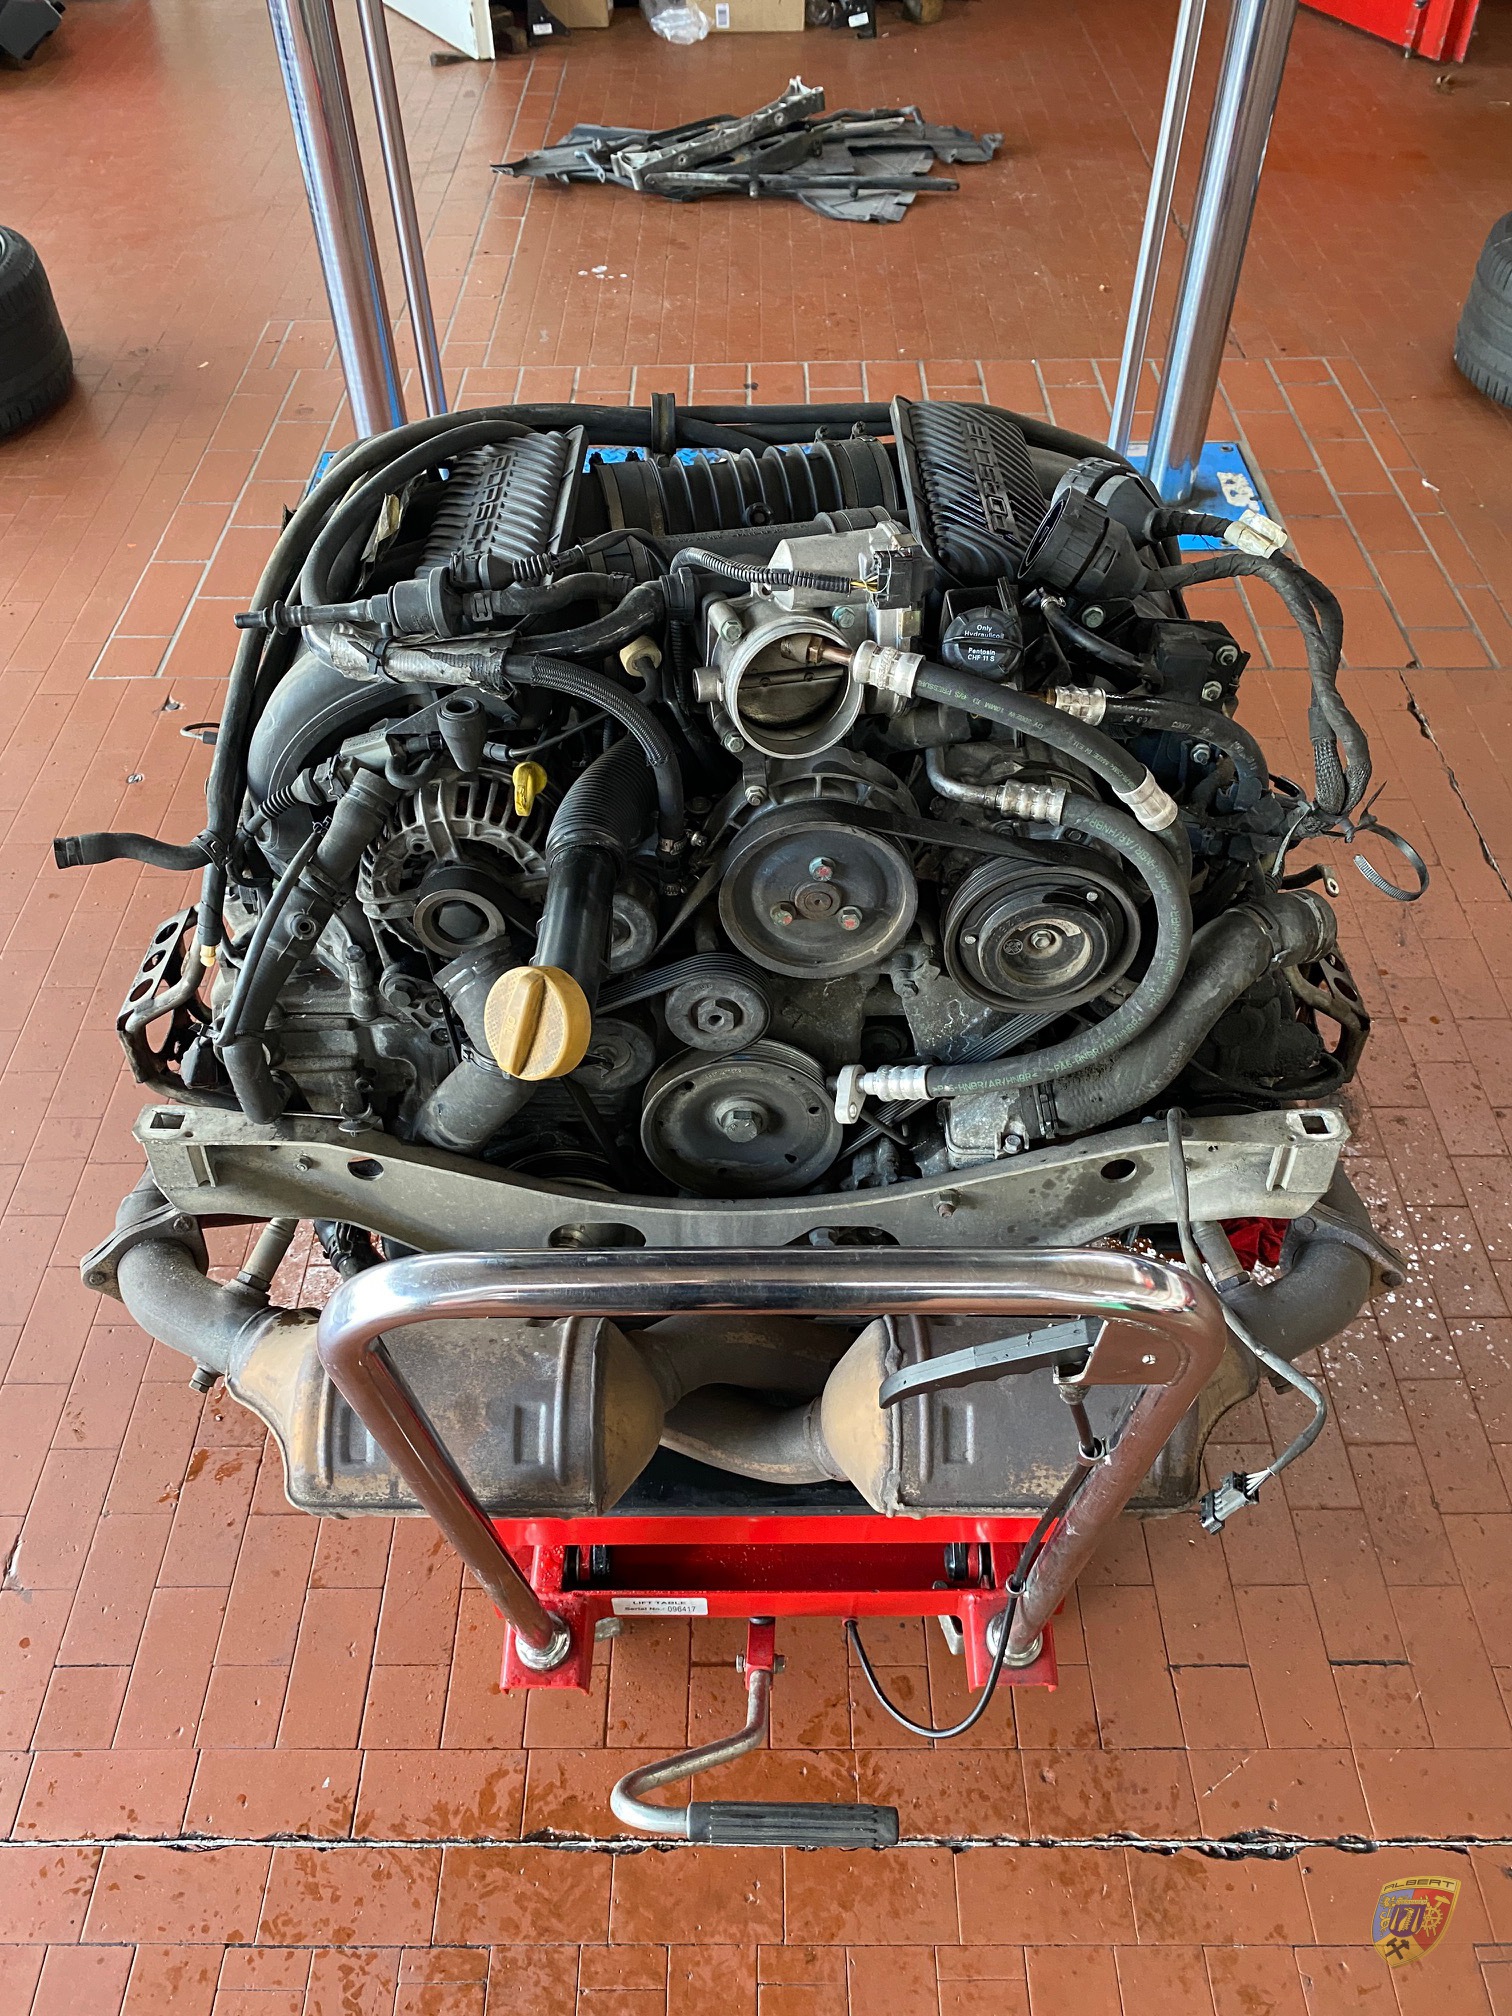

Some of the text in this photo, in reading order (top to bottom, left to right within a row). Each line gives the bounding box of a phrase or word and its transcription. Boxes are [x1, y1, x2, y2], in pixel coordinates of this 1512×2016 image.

[966, 421, 1014, 534] PORSCHE
[465, 454, 512, 557] PORSCH
[977, 624, 992, 632] Only
[968, 647, 996, 655] Pentosin
[932, 1072, 1039, 1092] >P6-HNBR/AR/HNBR<
